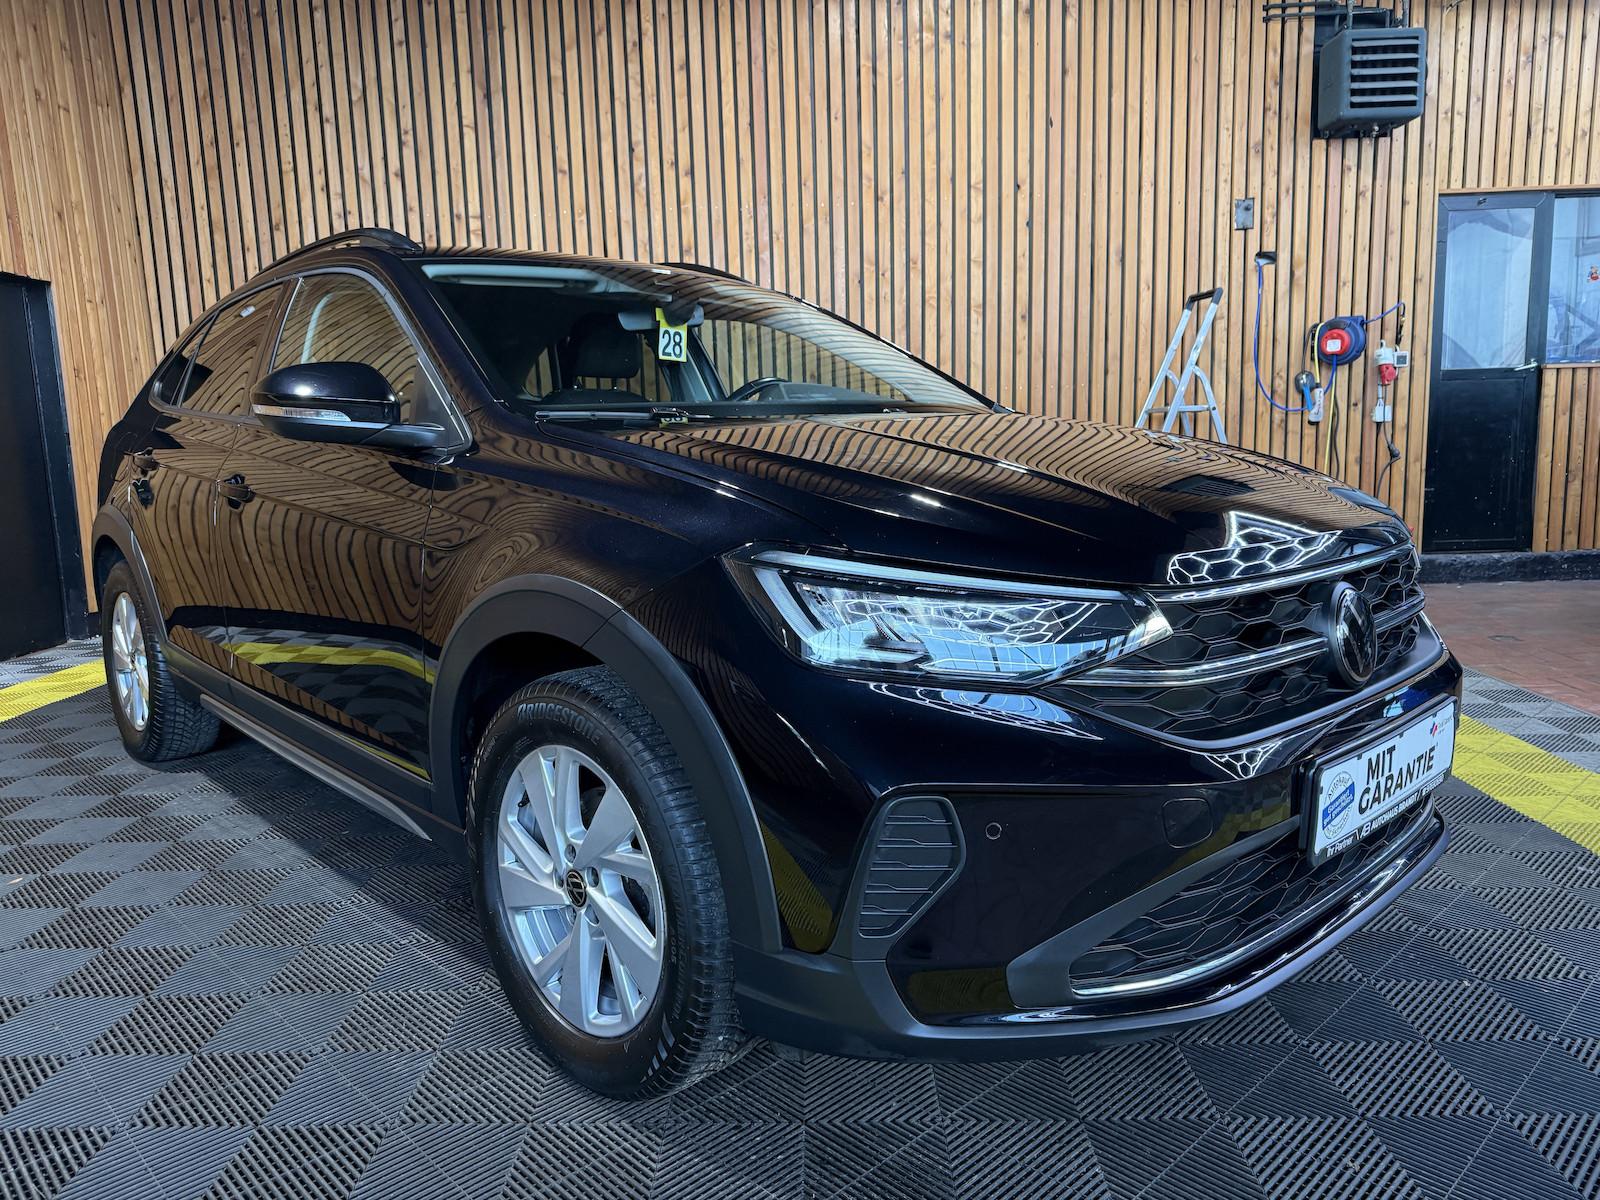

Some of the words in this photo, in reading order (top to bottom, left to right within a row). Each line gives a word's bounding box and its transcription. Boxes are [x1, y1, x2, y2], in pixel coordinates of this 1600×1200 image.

[661, 329, 683, 359] 28
[517, 702, 604, 745] BRIDGESTONE
[1358, 745, 1436, 815] GARANTIE
[1366, 744, 1396, 786] MIT
[1371, 805, 1399, 830] AUTOHAUS
[1335, 836, 1354, 853] Partner
